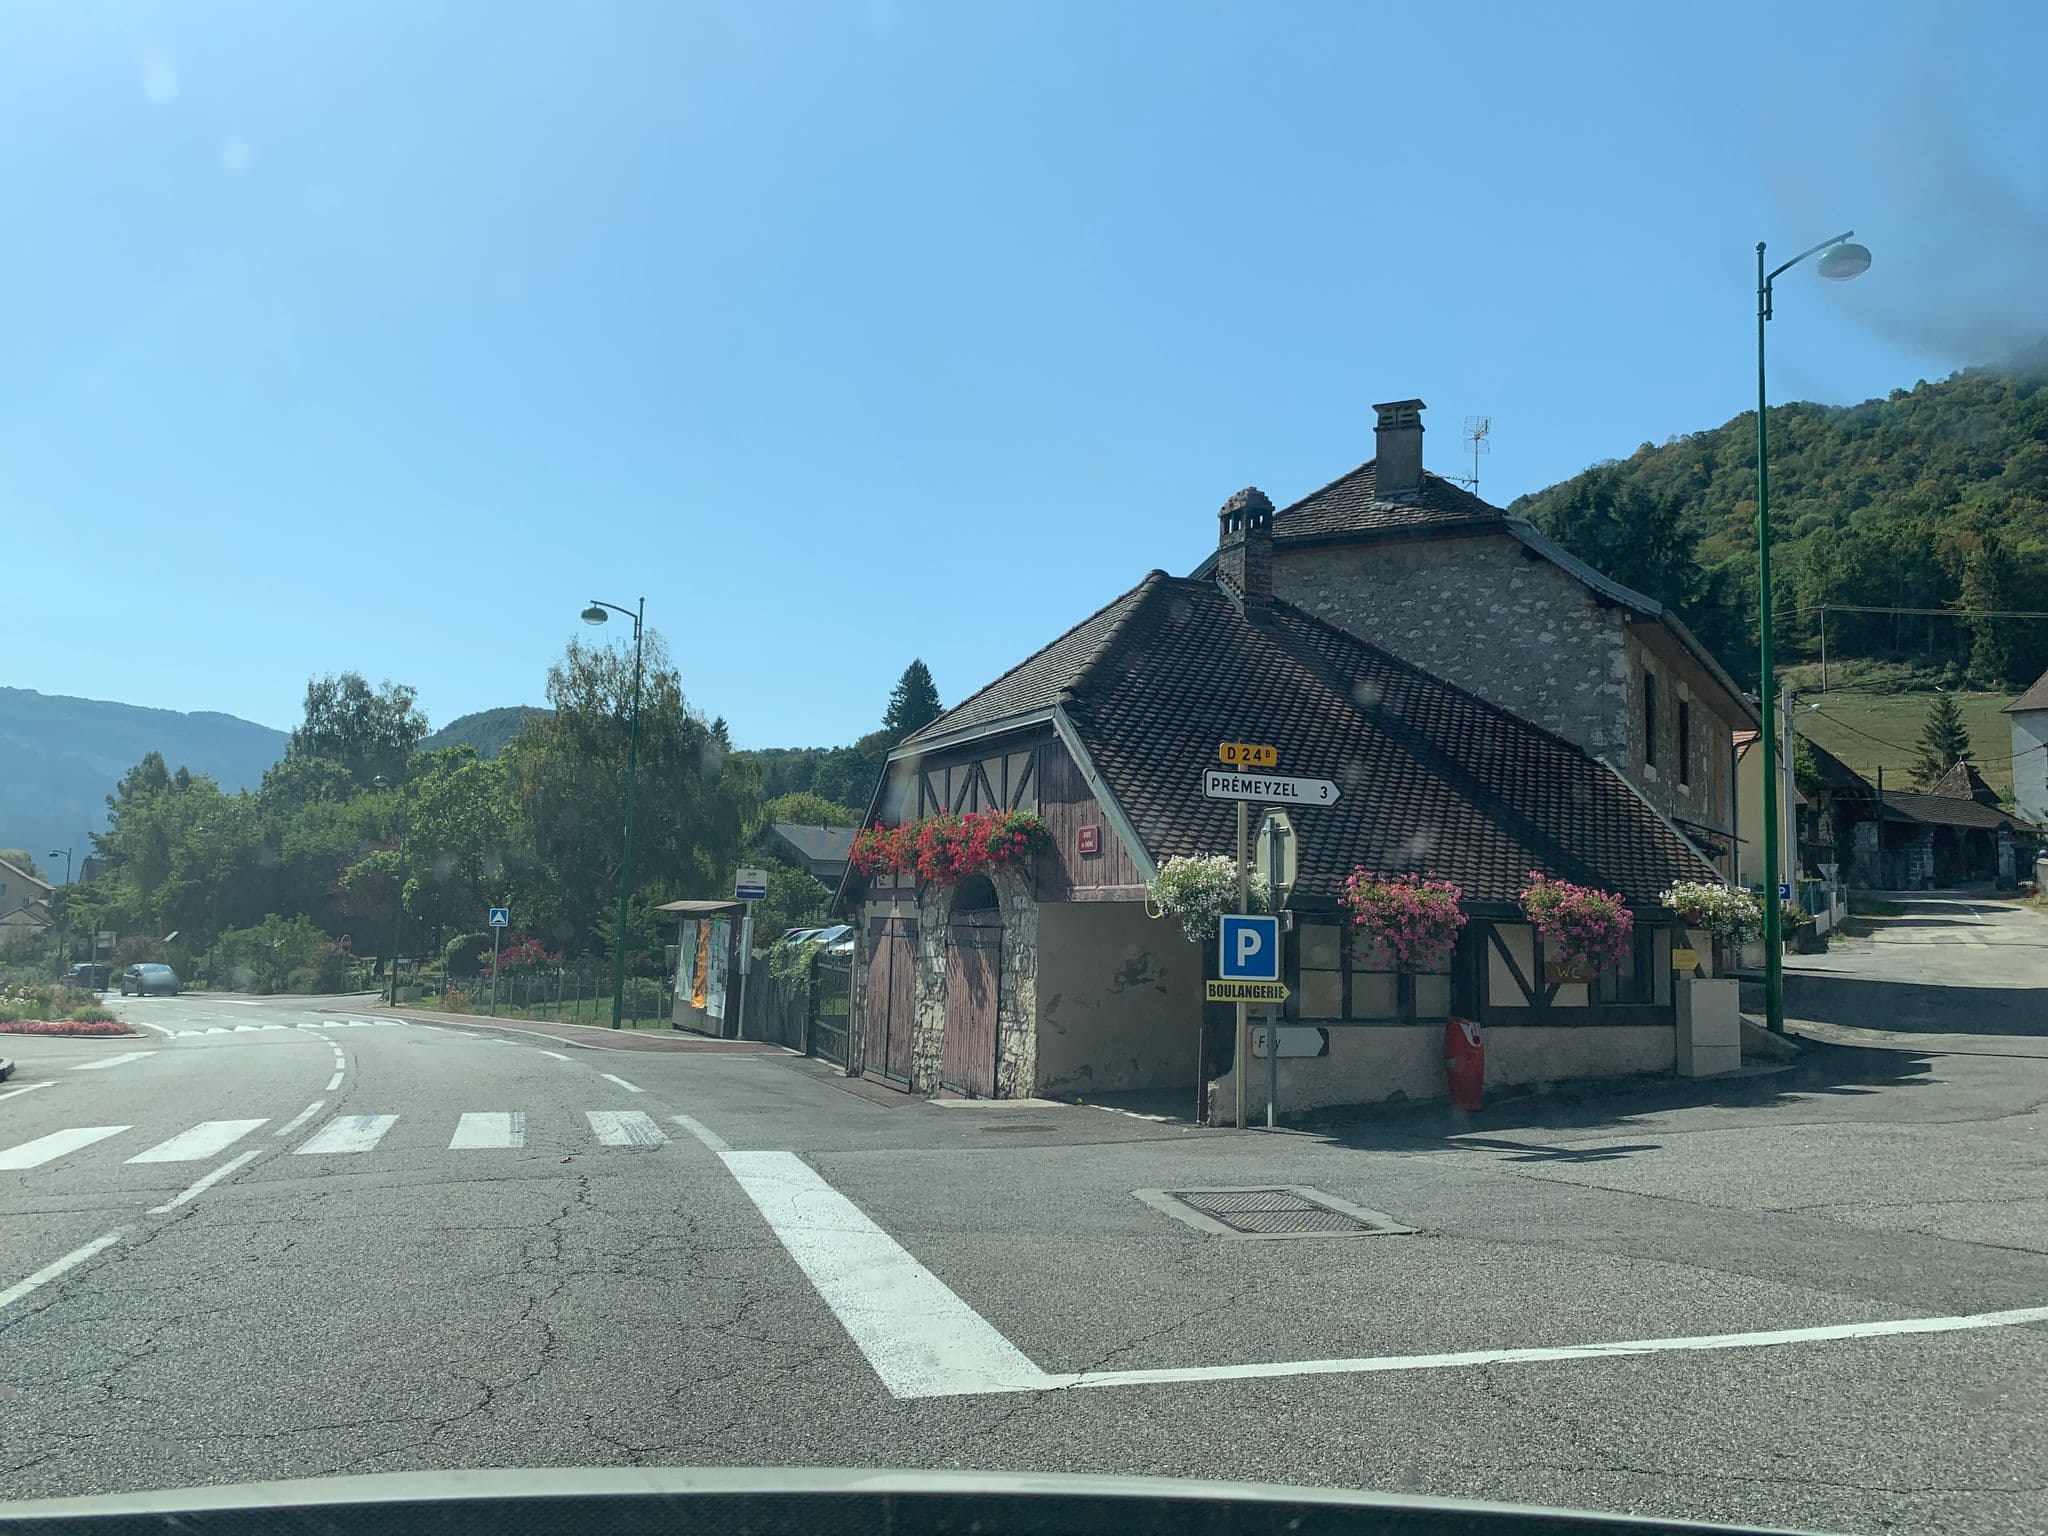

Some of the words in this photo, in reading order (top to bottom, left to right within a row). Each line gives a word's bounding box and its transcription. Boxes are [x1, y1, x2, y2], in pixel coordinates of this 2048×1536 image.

[1227, 747, 1236, 760] D
[1212, 776, 1299, 797] PRÉMEYZEL
[1319, 786, 1328, 799] 3
[1237, 928, 1262, 967] P
[1556, 964, 1581, 979] WC
[1208, 983, 1284, 999] BOULANGERIE
[1258, 1035, 1282, 1052] Fy
